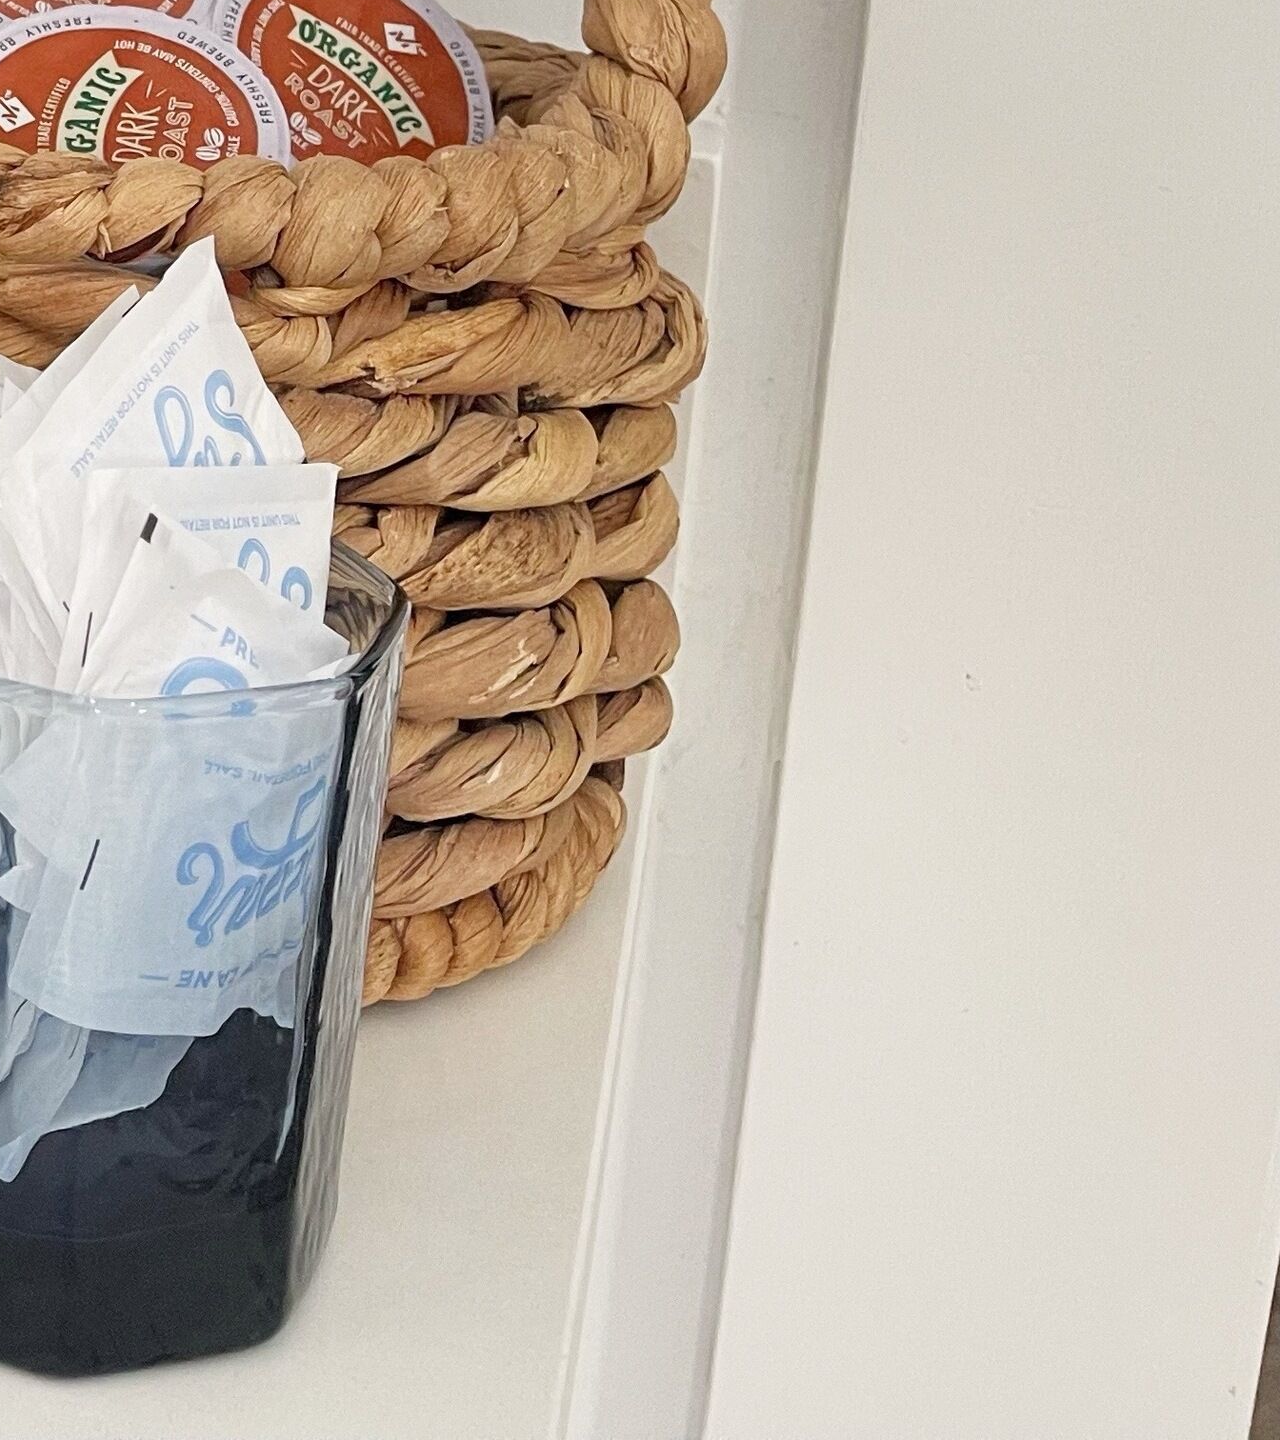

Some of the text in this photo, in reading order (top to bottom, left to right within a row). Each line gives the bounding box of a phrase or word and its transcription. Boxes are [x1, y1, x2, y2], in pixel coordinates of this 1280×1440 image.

[25, 16, 92, 38] FRESHLY
[114, 40, 135, 50] HOT
[152, 48, 177, 66] MAY
[177, 31, 275, 125] BREWED FRESHLY
[298, 18, 422, 133] ORGANIC
[64, 66, 127, 153] GANIC
[307, 64, 378, 129] DARK
[284, 72, 367, 149] ROAST
[112, 101, 162, 163] DARK
[158, 96, 194, 162] OAST
[178, 320, 200, 344] THIS
[161, 340, 180, 368] UNIT
[152, 363, 162, 378] IS
[133, 374, 154, 399] NOT
[119, 396, 137, 420] FOR
[96, 414, 121, 449] RETAIL
[211, 518, 230, 531] FOR
[232, 516, 250, 530] NOT
